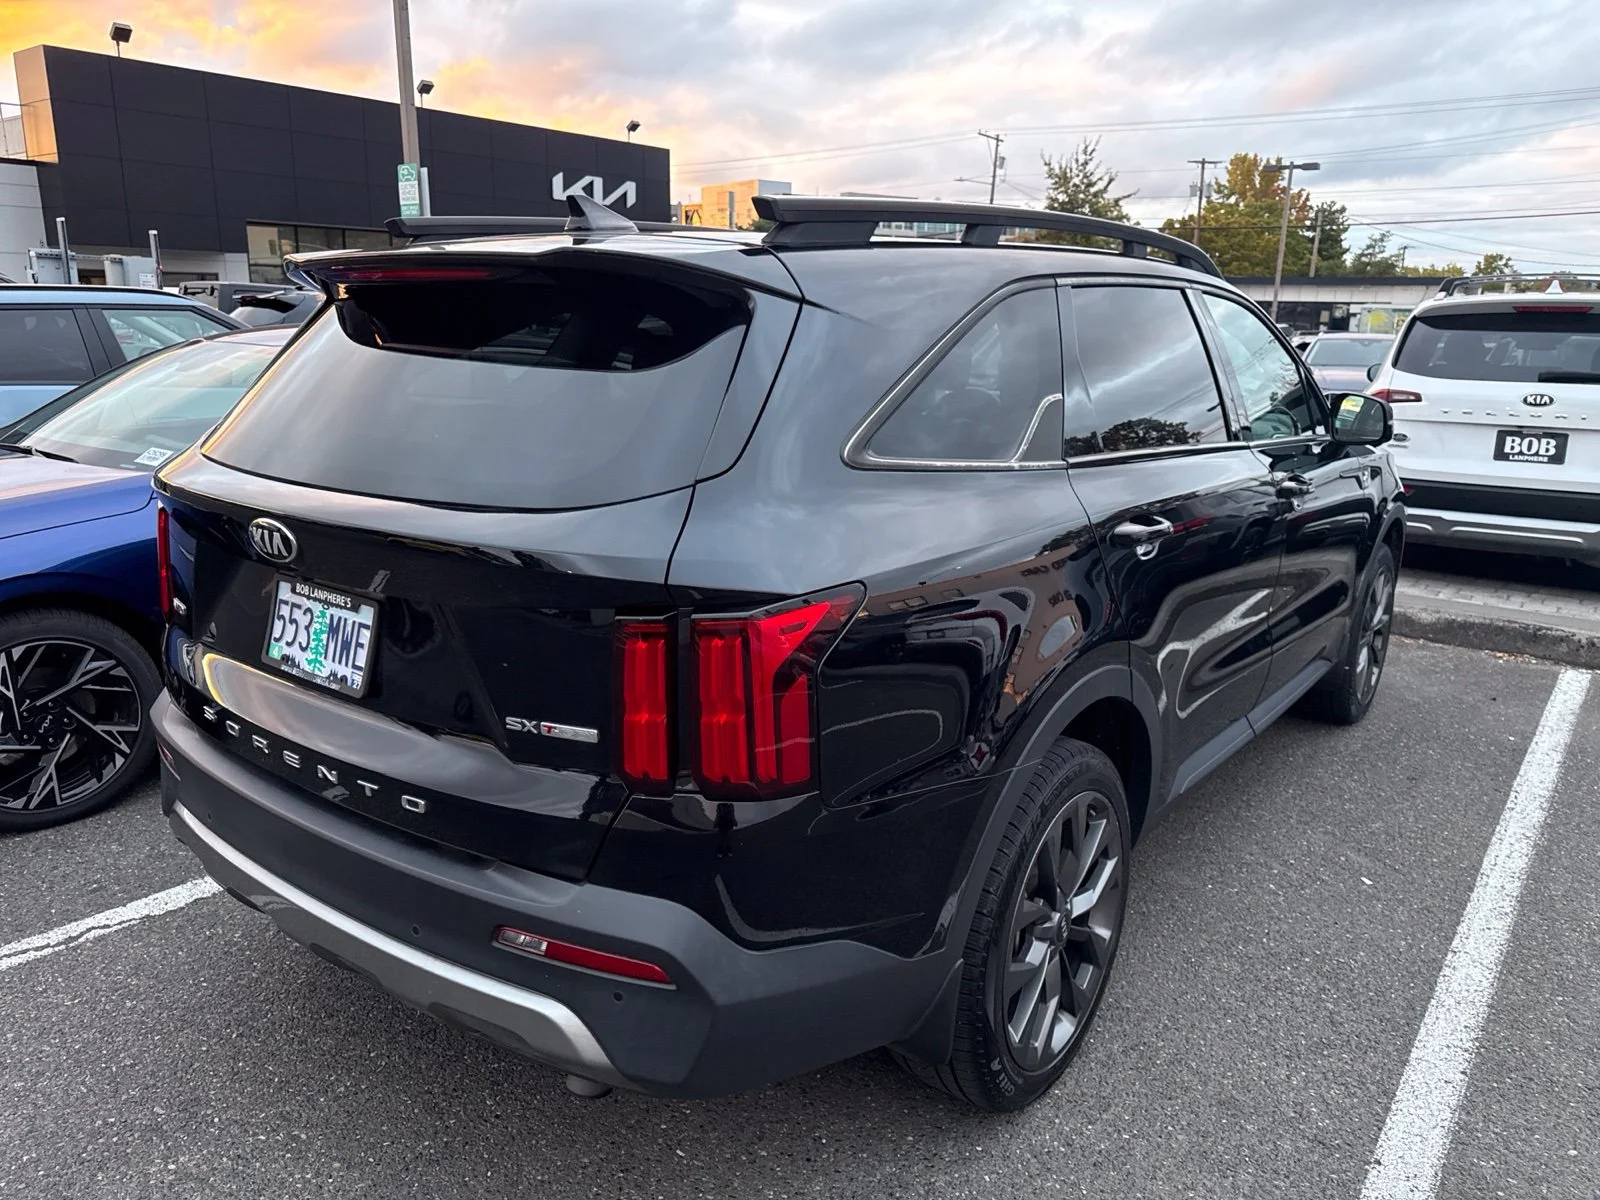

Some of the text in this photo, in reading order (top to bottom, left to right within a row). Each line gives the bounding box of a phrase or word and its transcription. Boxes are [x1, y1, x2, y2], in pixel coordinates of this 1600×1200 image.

[552, 172, 636, 208] KIA
[1526, 395, 1551, 405] KIA
[1504, 436, 1556, 456] BOB
[1509, 455, 1548, 463] LANPHERE
[251, 526, 289, 557] KIA
[296, 583, 351, 608] BOB LANPHERE'S
[273, 598, 370, 672] 553 MWE
[271, 646, 279, 657] 4
[353, 678, 362, 690] 27
[505, 716, 538, 734] SX
[203, 706, 427, 814] SORENTO
